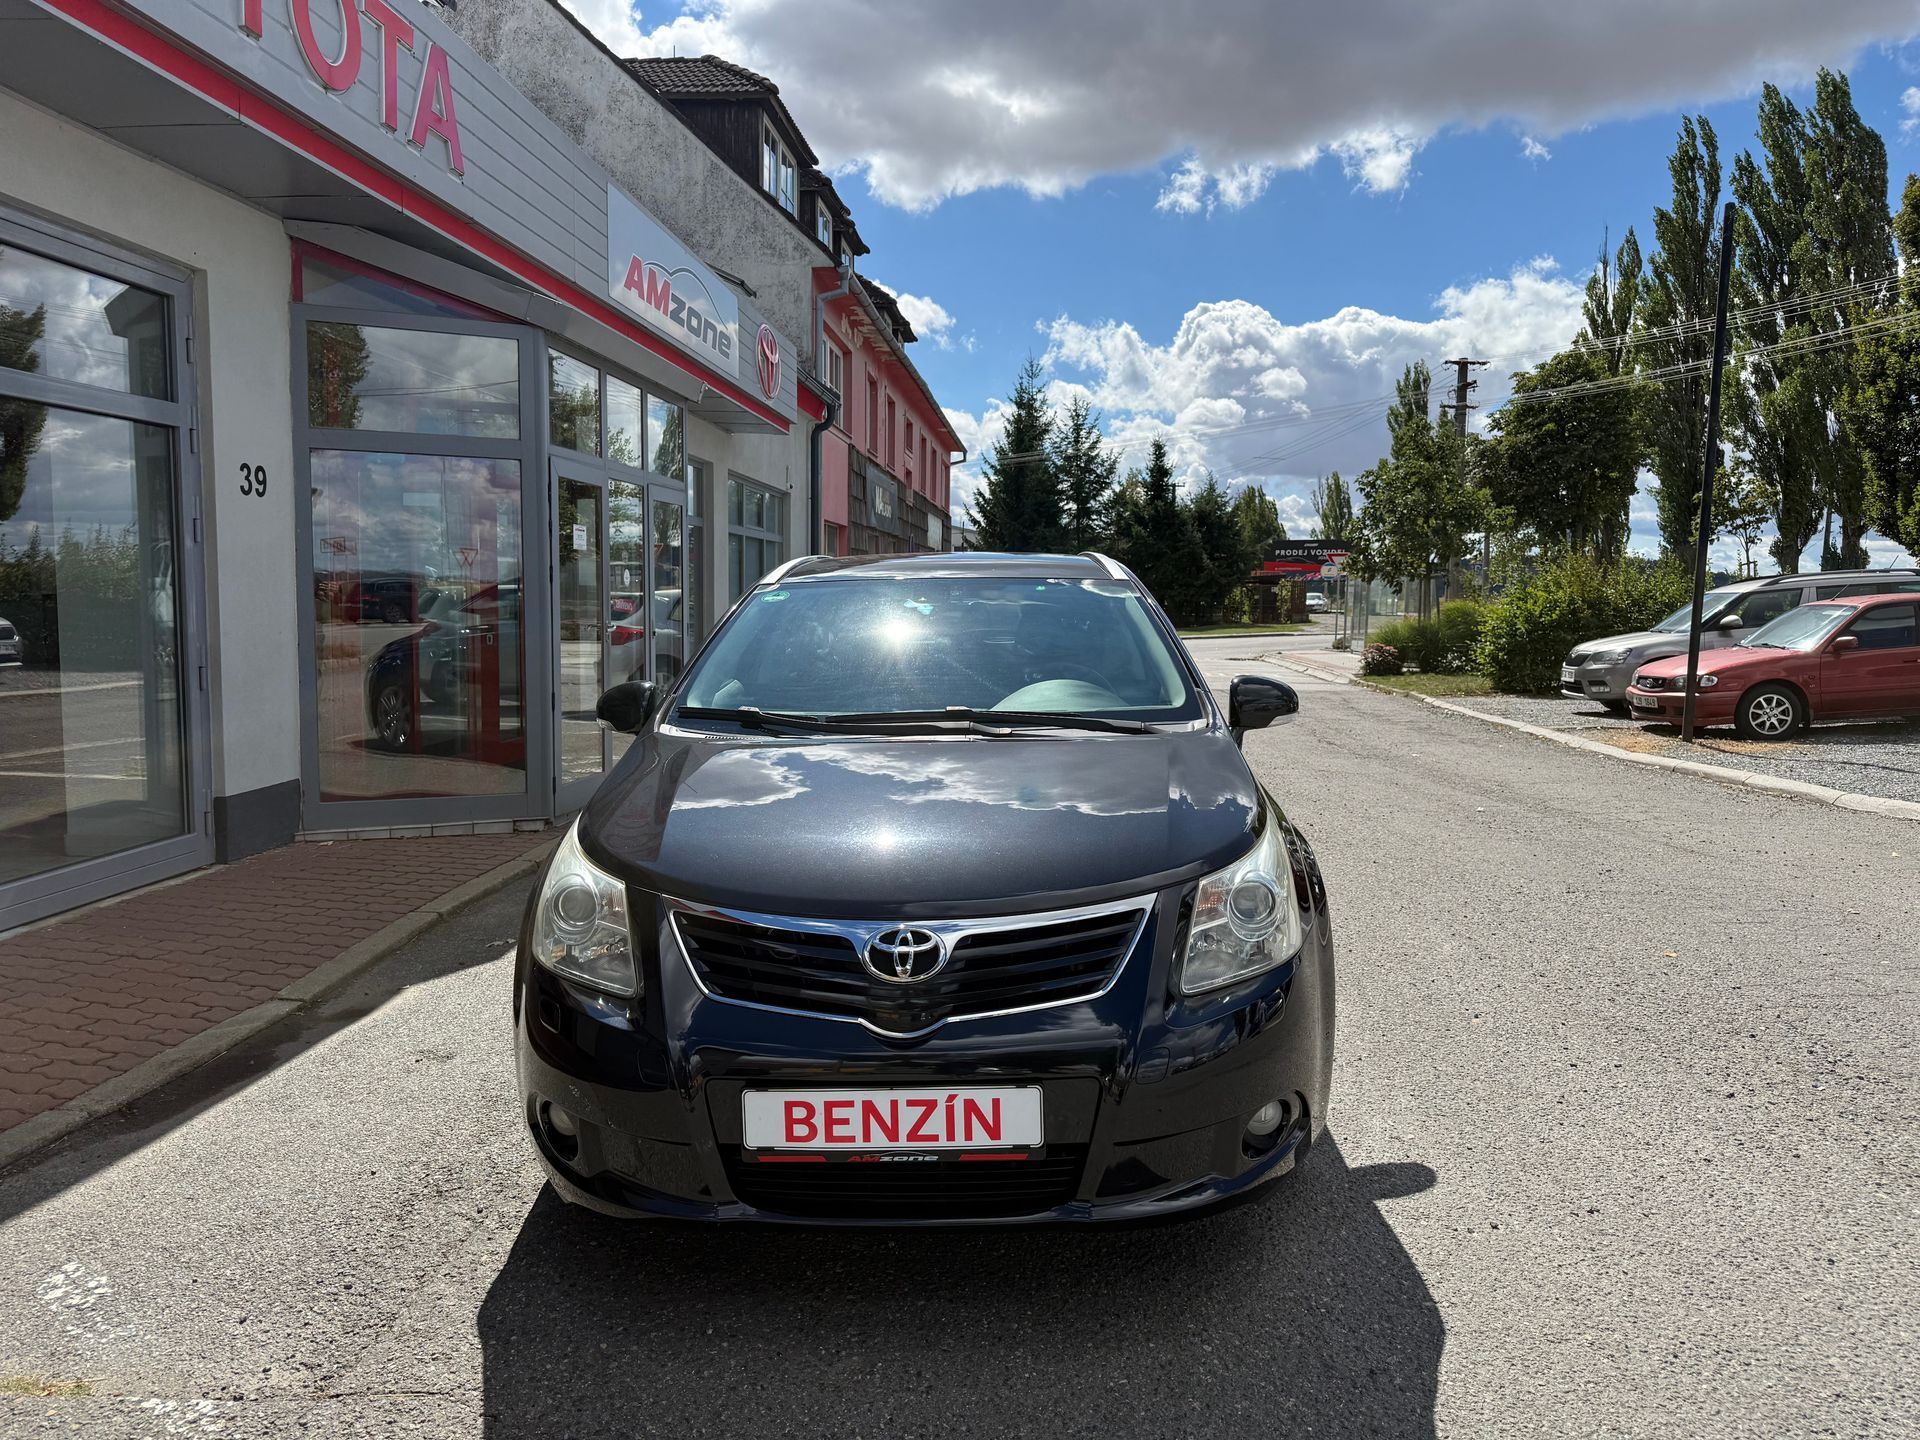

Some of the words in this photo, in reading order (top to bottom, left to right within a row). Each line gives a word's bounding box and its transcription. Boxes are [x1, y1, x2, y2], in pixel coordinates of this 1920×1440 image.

[624, 254, 732, 361] AMzone
[239, 463, 268, 498] 39
[783, 1094, 1001, 1144] BENZÍN
[846, 1154, 939, 1163] AMzone
